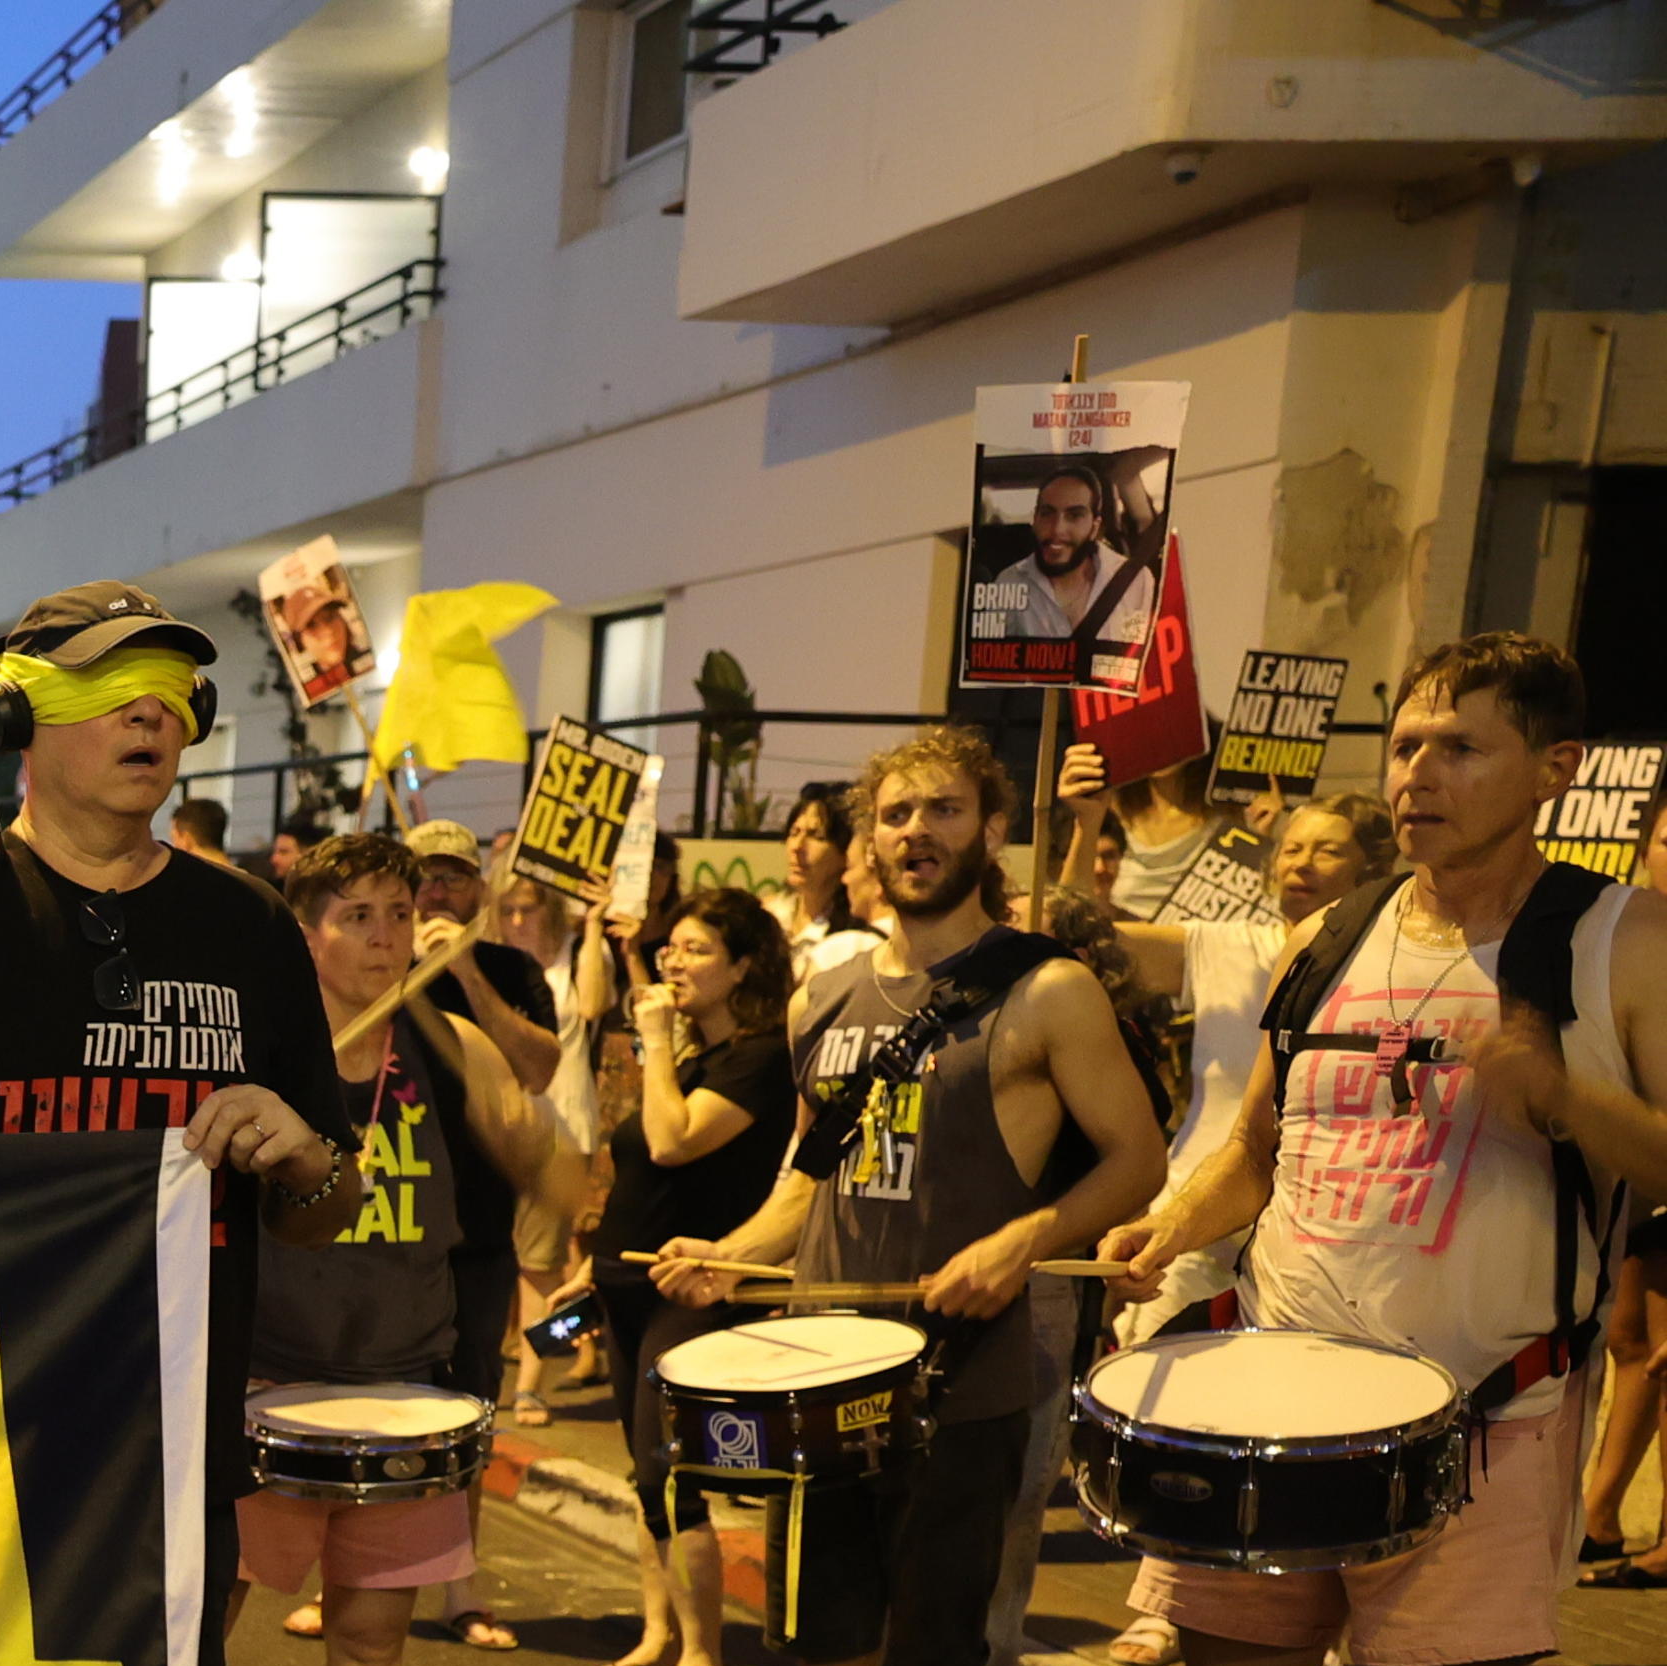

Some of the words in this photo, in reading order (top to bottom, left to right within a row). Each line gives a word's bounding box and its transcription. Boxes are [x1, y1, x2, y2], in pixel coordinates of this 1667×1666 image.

[973, 583, 1029, 611] BRING
[971, 612, 1006, 639] HIM
[970, 641, 1020, 669] HOME
[1025, 641, 1077, 670] NOW!
[1241, 654, 1344, 697] LEAVING
[1229, 692, 1274, 734] NO
[1271, 694, 1335, 739] ONE
[1220, 734, 1324, 779] BEHIND!
[540, 742, 630, 825] SEAL
[522, 793, 613, 877] DEAL
[1556, 788, 1651, 839] ONE
[143, 980, 241, 1028] מחזירים
[83, 1022, 173, 1069] הביתה
[179, 1026, 246, 1074] אותם
